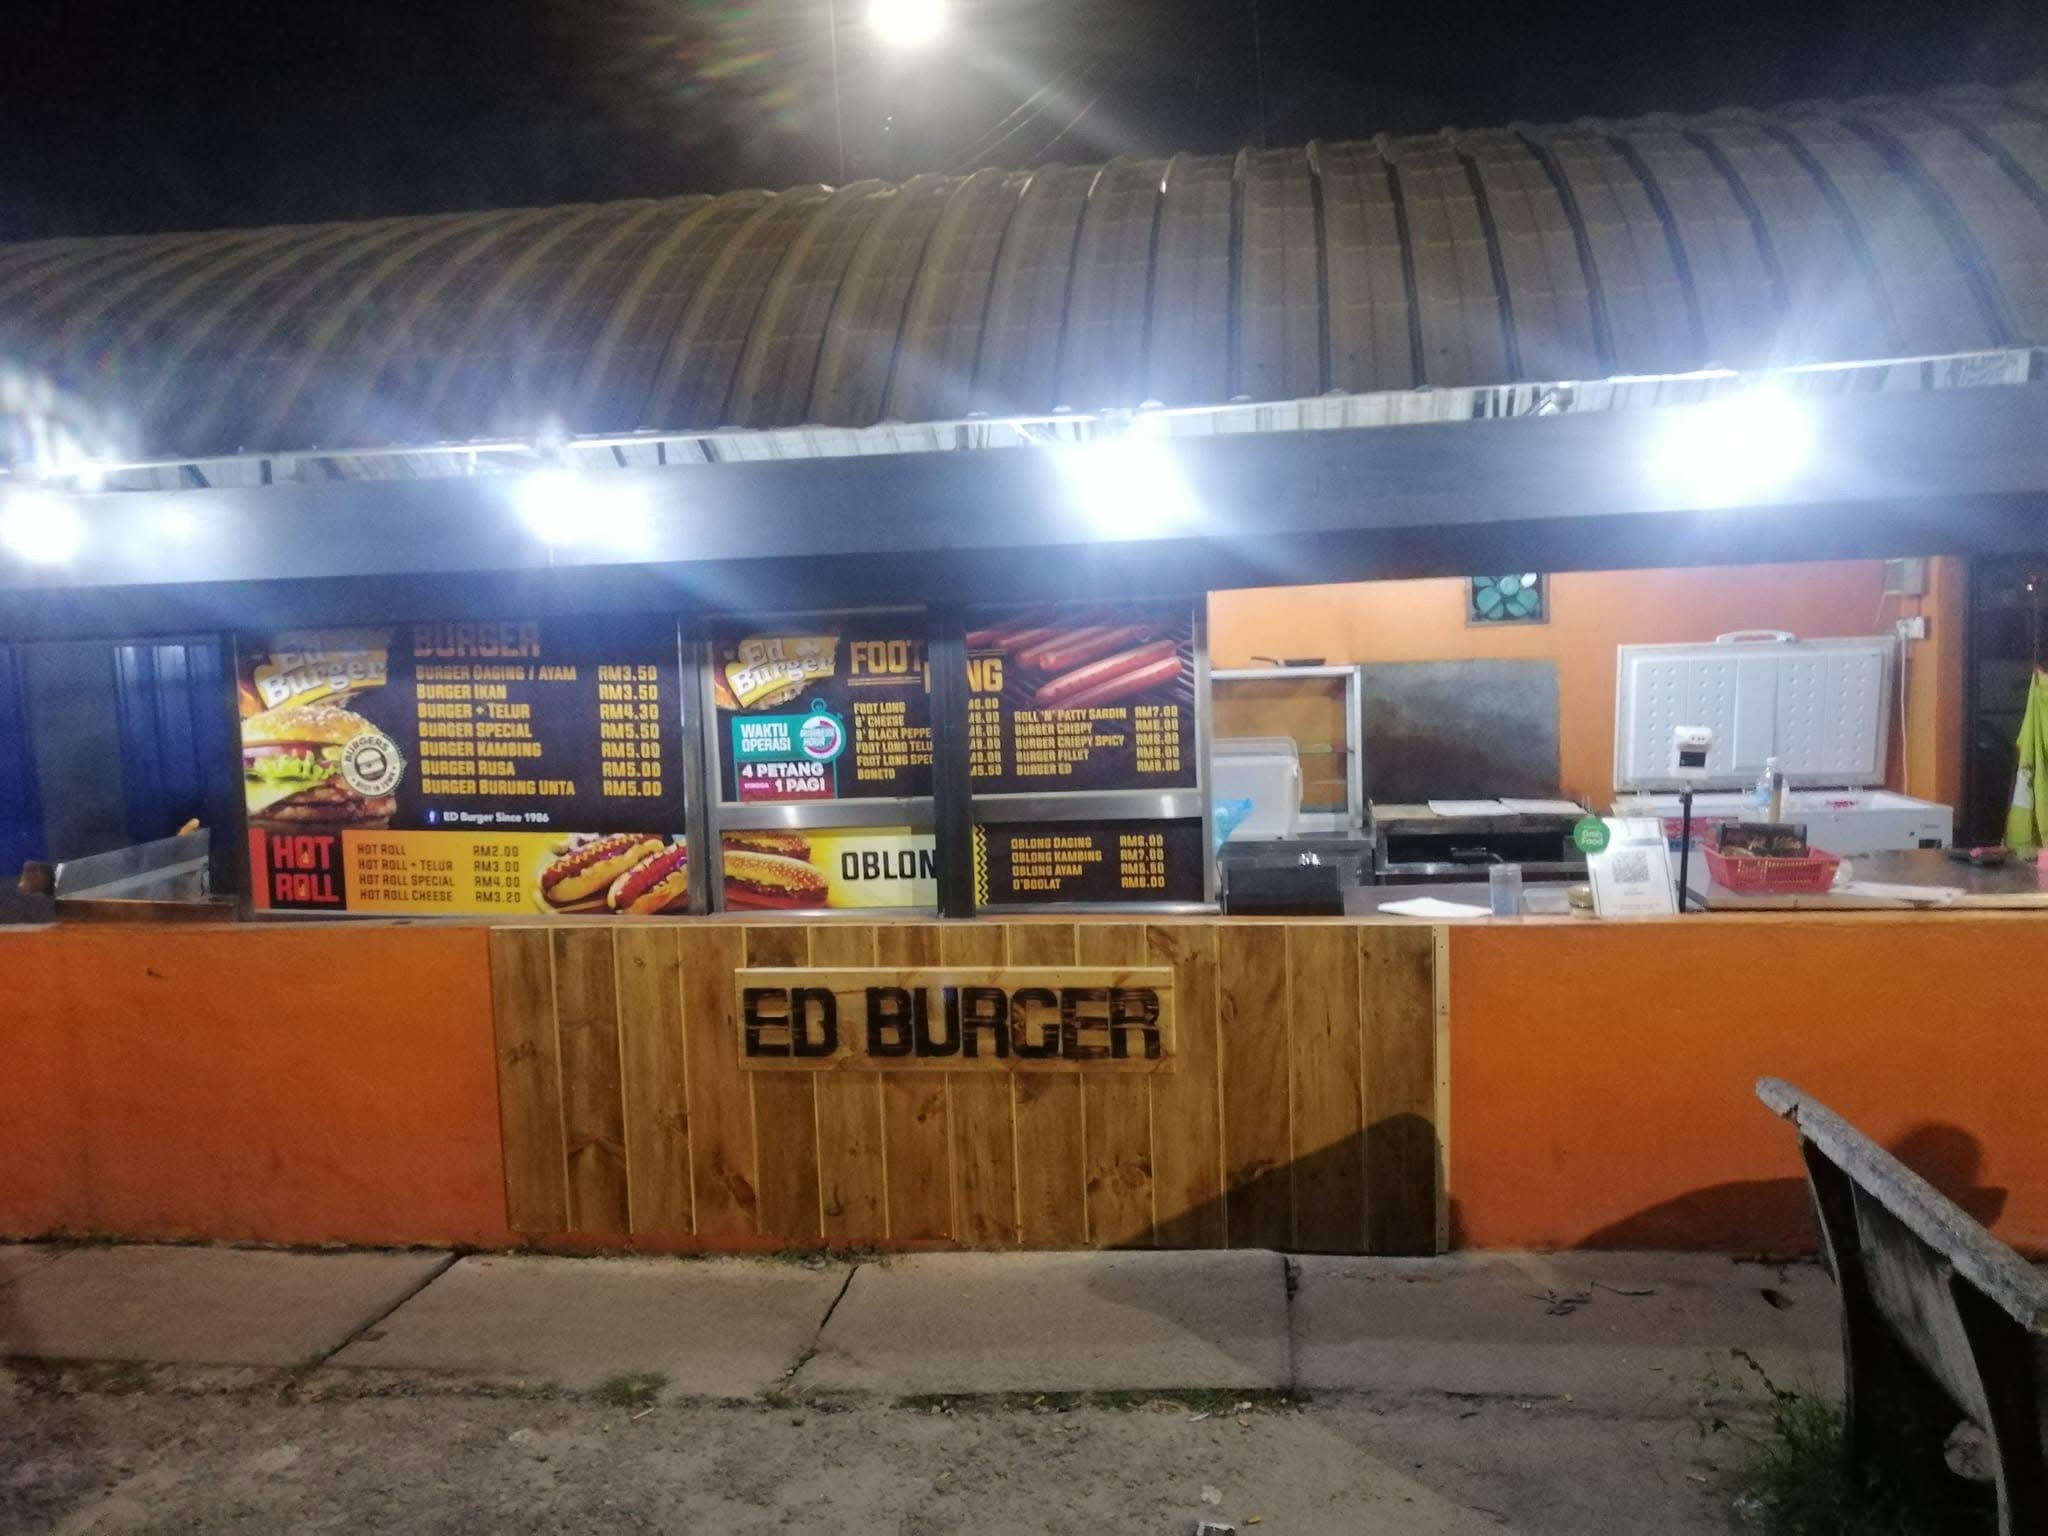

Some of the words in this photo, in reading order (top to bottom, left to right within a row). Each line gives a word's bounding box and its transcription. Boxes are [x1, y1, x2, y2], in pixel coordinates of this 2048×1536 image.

[414, 623, 540, 657] BURGER
[747, 637, 785, 667] Ed
[416, 665, 470, 681] BURGER
[538, 665, 577, 680] AYAM
[598, 665, 657, 681] RM3.50
[730, 656, 836, 697] Burger
[259, 659, 387, 708] Burger
[416, 683, 471, 699] BURGER
[474, 685, 507, 699] IKAN
[599, 684, 658, 700] RM3.50
[418, 703, 472, 718] BURGER
[487, 703, 530, 718] TELUR
[600, 703, 658, 720] RM4.30
[854, 702, 878, 714] FOOT
[879, 702, 906, 714] LONG
[1014, 711, 1038, 722] ROLL
[1058, 710, 1088, 721] PATTY
[1089, 708, 1126, 719] SARDIN
[419, 722, 473, 737] BURGER
[476, 722, 532, 737] SPECIAL
[601, 723, 660, 739] RM5.50
[740, 723, 788, 738] WAKTU
[868, 729, 899, 741] BLACK
[1015, 723, 1054, 735] BURGER
[1057, 722, 1092, 734] CRISPY
[345, 736, 389, 762] BURGERS
[420, 741, 474, 756] BURGER
[477, 741, 542, 757] KAMBING
[742, 738, 791, 752] OPERASI
[856, 741, 881, 754] FOOT
[882, 741, 907, 753] LONG
[1016, 737, 1055, 749] BURGER
[1057, 735, 1093, 748] CRISPY
[1095, 735, 1124, 746] SPICY
[602, 742, 660, 758] RM5.00
[1016, 751, 1056, 762] BURGER
[1058, 749, 1090, 761] FILLET
[857, 754, 881, 766] FOOT
[883, 754, 908, 766] LONG
[421, 760, 475, 775] BURGER
[478, 761, 516, 776] RUSA
[603, 761, 661, 777] RM5.00
[742, 764, 753, 778] 4
[757, 763, 824, 778] PETANG
[1017, 764, 1056, 776] BURGER
[422, 779, 476, 794] BURGER
[479, 779, 536, 795] BURUNG
[539, 781, 575, 795] UNTA
[603, 780, 662, 796] RM5.00
[775, 780, 783, 792] 1
[785, 778, 826, 792] PAGI
[443, 811, 459, 822] ED
[460, 812, 494, 824] Burger
[496, 812, 522, 823] Since
[357, 844, 377, 855] HOT
[381, 844, 406, 856] ROLL
[473, 845, 519, 857] RM2.00
[1011, 838, 1051, 849] OBLONG
[272, 835, 334, 869] HOT
[1012, 852, 1051, 863] OBLONG
[1054, 851, 1102, 862] KAMBING
[358, 860, 378, 871] HOT
[382, 860, 407, 871] ROLL
[421, 861, 453, 872] TELUR
[474, 861, 520, 873] RM3.00
[841, 850, 936, 880] OBLON
[1012, 865, 1051, 876] OBLONG
[1054, 864, 1082, 875] AYAM
[275, 873, 339, 902] ROLL
[359, 875, 379, 886] HOT
[383, 875, 408, 886] ROLL
[411, 876, 455, 887] SPECIAL
[474, 876, 521, 888] RM4.00
[360, 890, 380, 901] HOT
[383, 890, 409, 901] ROLL
[412, 890, 453, 902] CHEESE
[476, 891, 521, 903] RM3.20
[744, 987, 838, 1058] ED
[866, 985, 1160, 1059] BURGER
